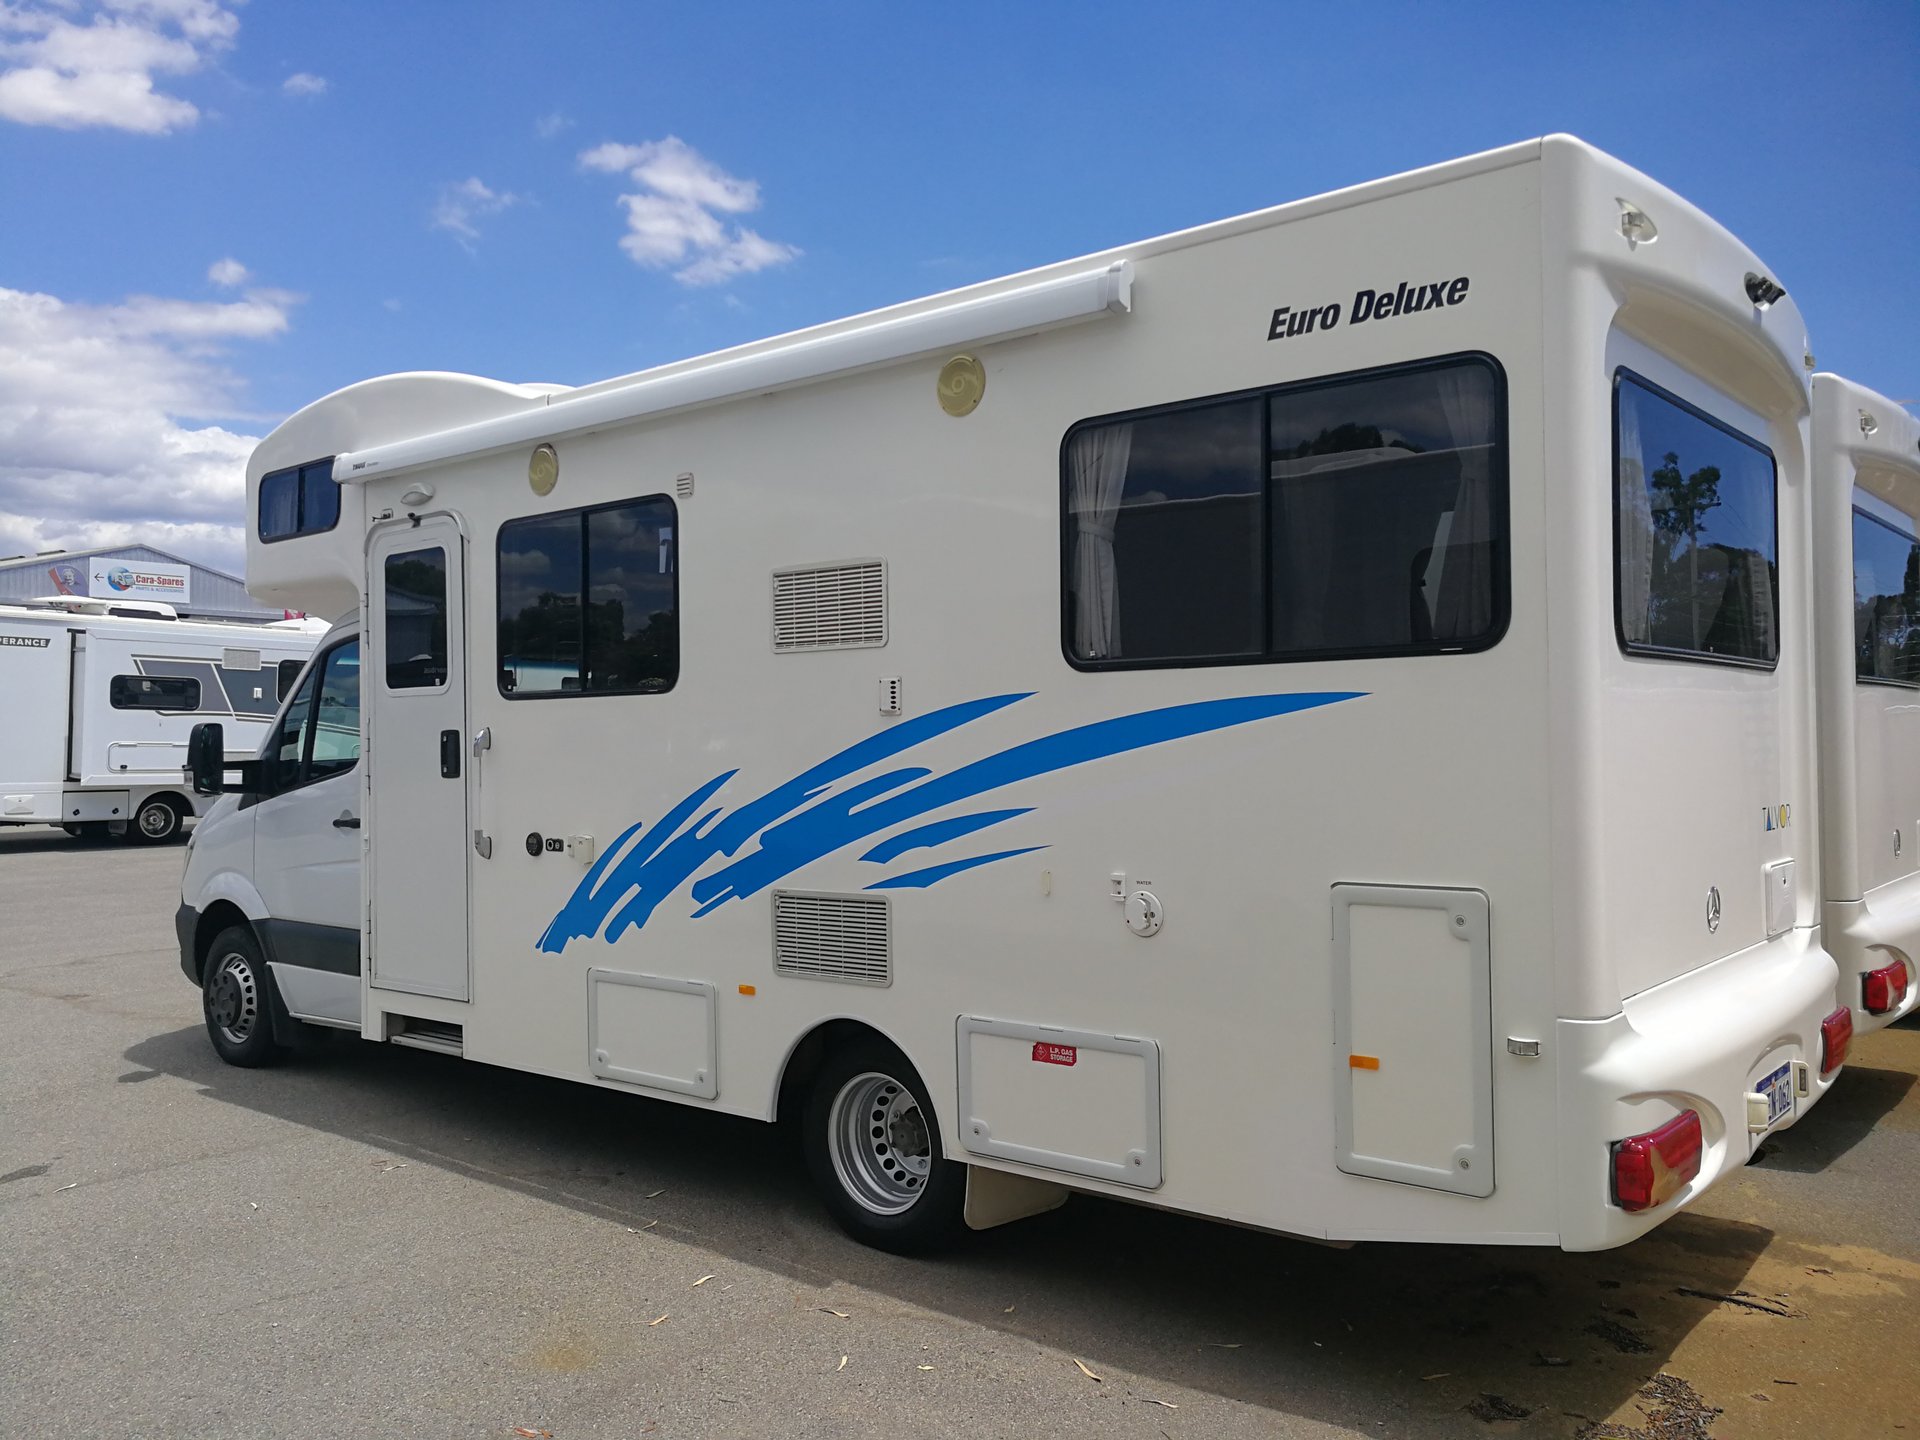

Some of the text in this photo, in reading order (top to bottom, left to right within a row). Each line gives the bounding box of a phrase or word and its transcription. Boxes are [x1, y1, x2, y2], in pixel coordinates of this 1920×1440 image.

[1267, 276, 1470, 341] Euro Deluxe
[135, 575, 185, 587] Cara-Spares
[0, 637, 47, 647] ERANCE
[1762, 803, 1791, 832] TALVOR
[1061, 1048, 1073, 1057] GAS
[1050, 1054, 1073, 1063] STORAGE
